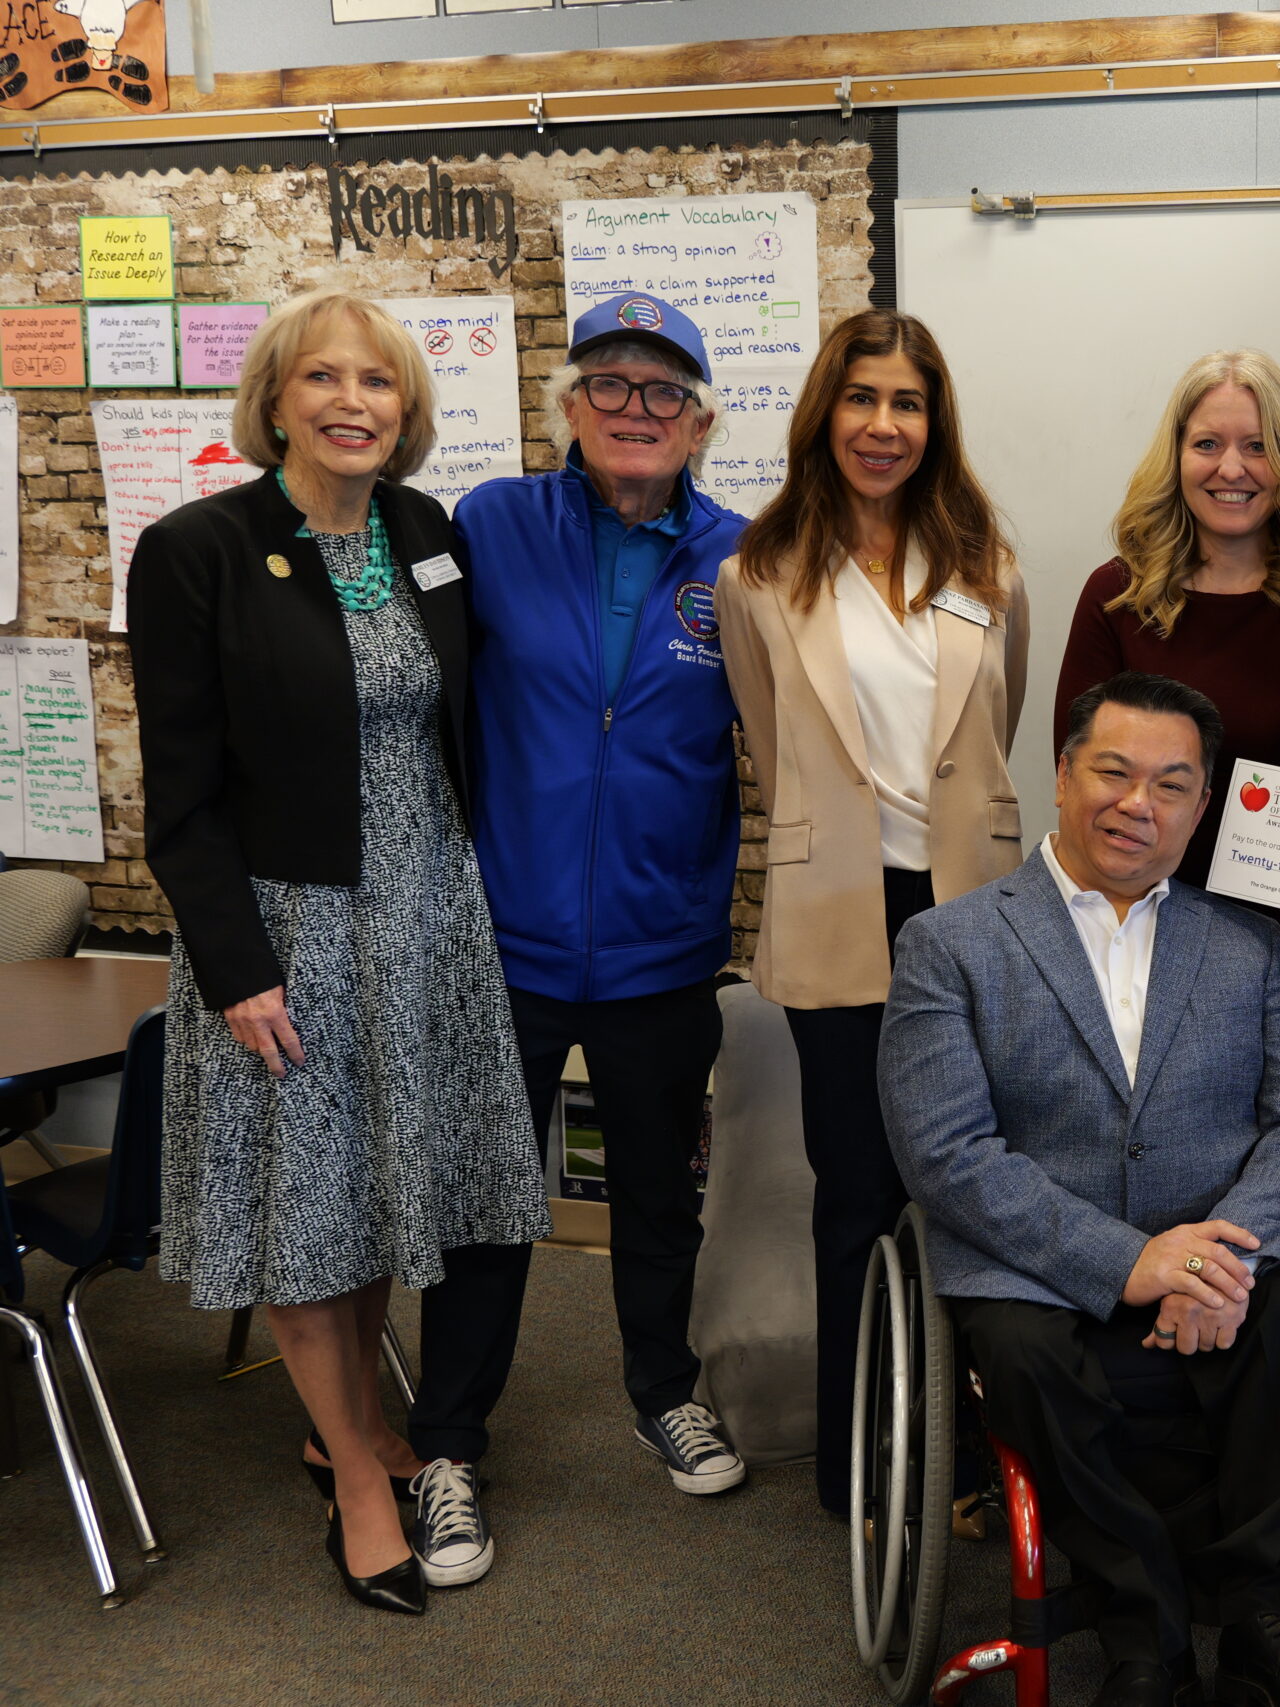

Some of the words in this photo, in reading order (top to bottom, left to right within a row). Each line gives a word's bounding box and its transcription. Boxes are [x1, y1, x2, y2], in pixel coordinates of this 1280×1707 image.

[326, 162, 518, 278] Reading
[585, 207, 671, 237] Argument
[680, 205, 777, 227] Vocabulary
[104, 230, 130, 244] How
[133, 231, 147, 243] to
[89, 248, 145, 263] Research
[148, 250, 163, 262] an
[570, 243, 612, 258] claim:
[616, 245, 627, 256] a
[632, 243, 678, 263] strong
[684, 244, 737, 261] opinion
[87, 266, 122, 280] Issue
[125, 266, 167, 283] Deeply
[570, 277, 638, 298] argument:
[645, 279, 655, 291] a
[659, 276, 698, 291] claim
[704, 270, 776, 294] supported
[671, 294, 699, 308] and
[702, 289, 774, 306] evidence.
[17, 317, 38, 327] aside
[40, 319, 59, 330] your
[99, 317, 120, 327] Make
[122, 319, 128, 327] a
[131, 316, 160, 329] reading
[188, 321, 219, 331] Gather
[220, 321, 258, 331] evidence
[418, 317, 453, 335] open
[457, 311, 500, 328] mind!
[15, 330, 48, 342] opinions
[49, 328, 64, 338] and
[118, 329, 136, 341] plan
[187, 334, 202, 344] for
[203, 333, 224, 344] both
[225, 334, 249, 344] sides
[700, 326, 709, 338] a
[714, 324, 755, 338] claim
[5, 341, 39, 354] suspend
[38, 341, 77, 353] judgment
[204, 346, 219, 357] the
[221, 346, 245, 357] issue
[713, 341, 743, 363] good
[748, 338, 804, 355] reasons.
[737, 384, 773, 401] gives
[777, 385, 791, 397] a
[751, 397, 770, 412] of
[775, 400, 796, 412] an
[102, 404, 145, 421] Should
[151, 406, 174, 420] kids
[177, 407, 198, 425] play
[440, 406, 479, 425] being
[121, 426, 141, 440] yes
[210, 427, 225, 437] no
[101, 441, 130, 453] Don't
[440, 436, 515, 459] presented?
[427, 463, 441, 476] is
[446, 456, 493, 481] given?
[710, 455, 750, 471] that
[755, 454, 787, 477] give
[714, 474, 785, 495] argument
[16, 646, 33, 655] we
[36, 645, 75, 658] explore?
[668, 638, 695, 653] Chris
[676, 651, 697, 664] Board
[697, 655, 721, 669] Member
[48, 669, 73, 680] Space
[1231, 832, 1246, 845] Pay
[1246, 836, 1255, 845] to
[1255, 838, 1269, 848] the
[1250, 880, 1260, 889] The
[1260, 883, 1279, 893] Orange
